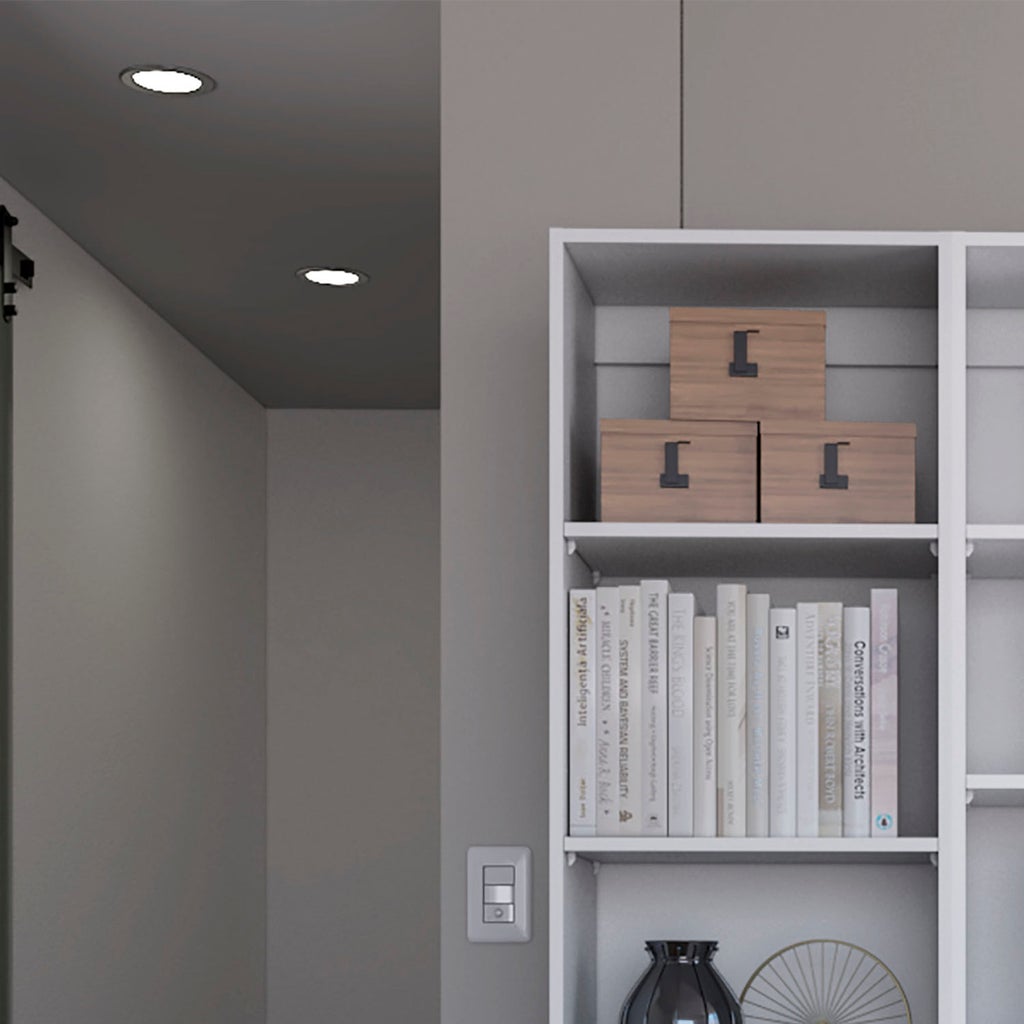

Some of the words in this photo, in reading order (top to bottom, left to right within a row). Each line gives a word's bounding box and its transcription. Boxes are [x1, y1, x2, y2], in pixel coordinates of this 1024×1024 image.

[649, 593, 659, 609] THE
[649, 611, 659, 636] GREAT
[672, 609, 685, 631] THE
[727, 633, 736, 642] AT
[619, 640, 628, 676] SYSTEM
[649, 639, 659, 673] BARRIER
[600, 664, 611, 711] CHILDREN
[619, 679, 628, 699] AND
[649, 675, 659, 694] REEF
[854, 641, 867, 717] Conversations
[672, 677, 685, 717] BLOOD
[619, 701, 628, 745] BAYESIAN
[854, 720, 867, 744] with
[619, 747, 628, 799] RELIABILITY
[854, 747, 867, 800] Architects
